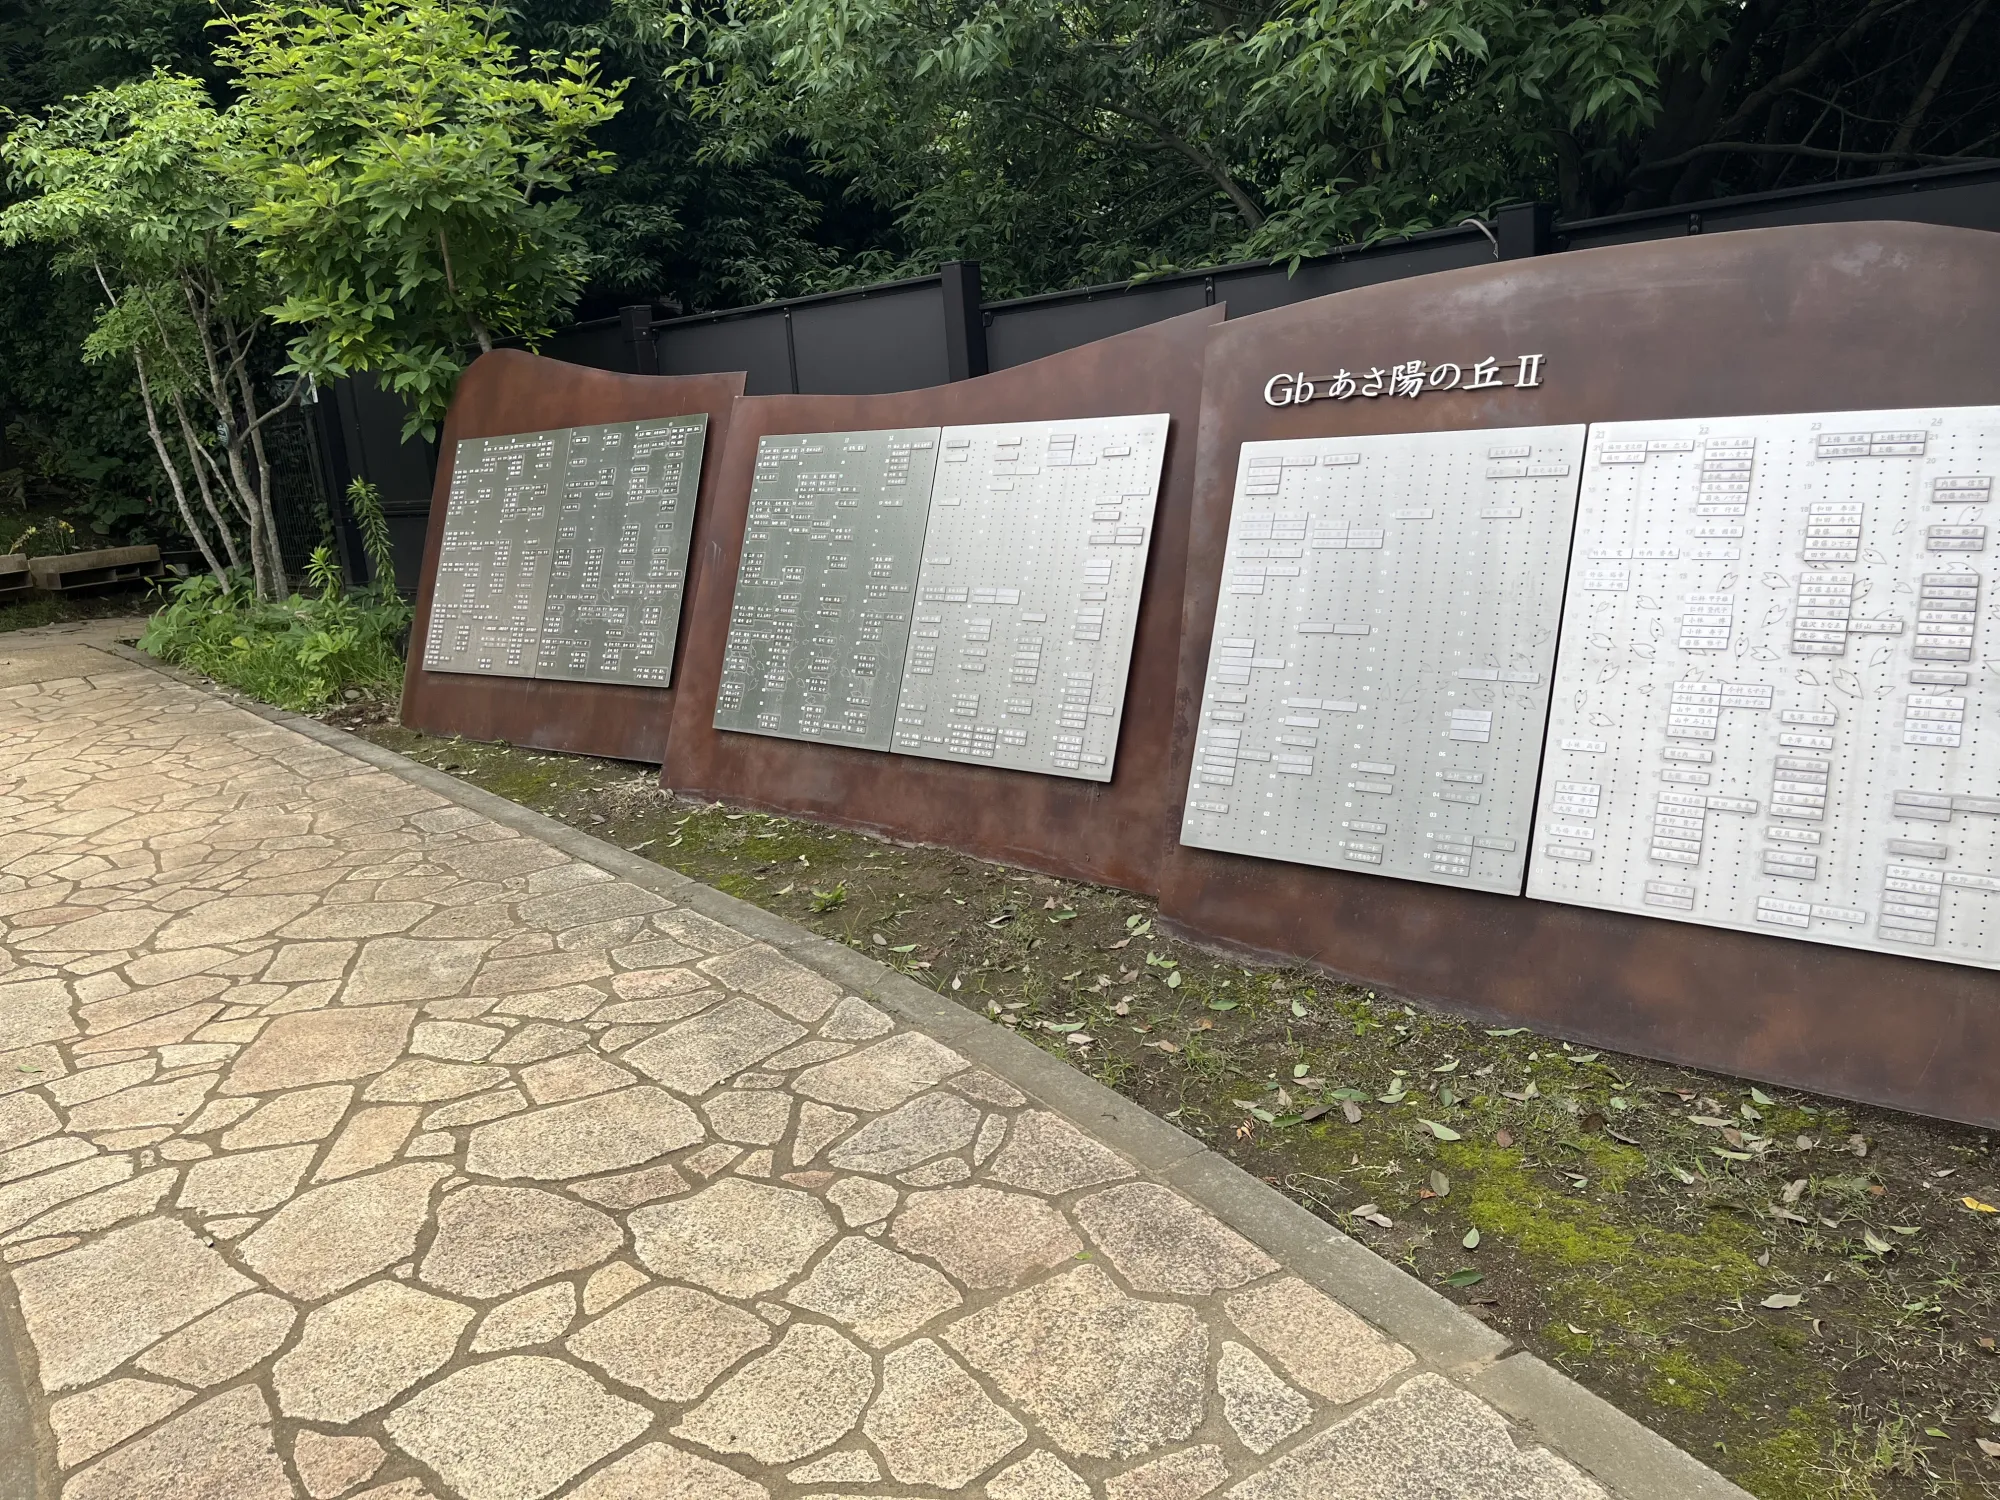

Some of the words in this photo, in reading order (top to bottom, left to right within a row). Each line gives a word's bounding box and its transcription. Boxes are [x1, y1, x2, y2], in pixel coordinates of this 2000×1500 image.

[1264, 371, 1314, 407] Gb
[1329, 356, 1503, 400] あさ陽の丘
